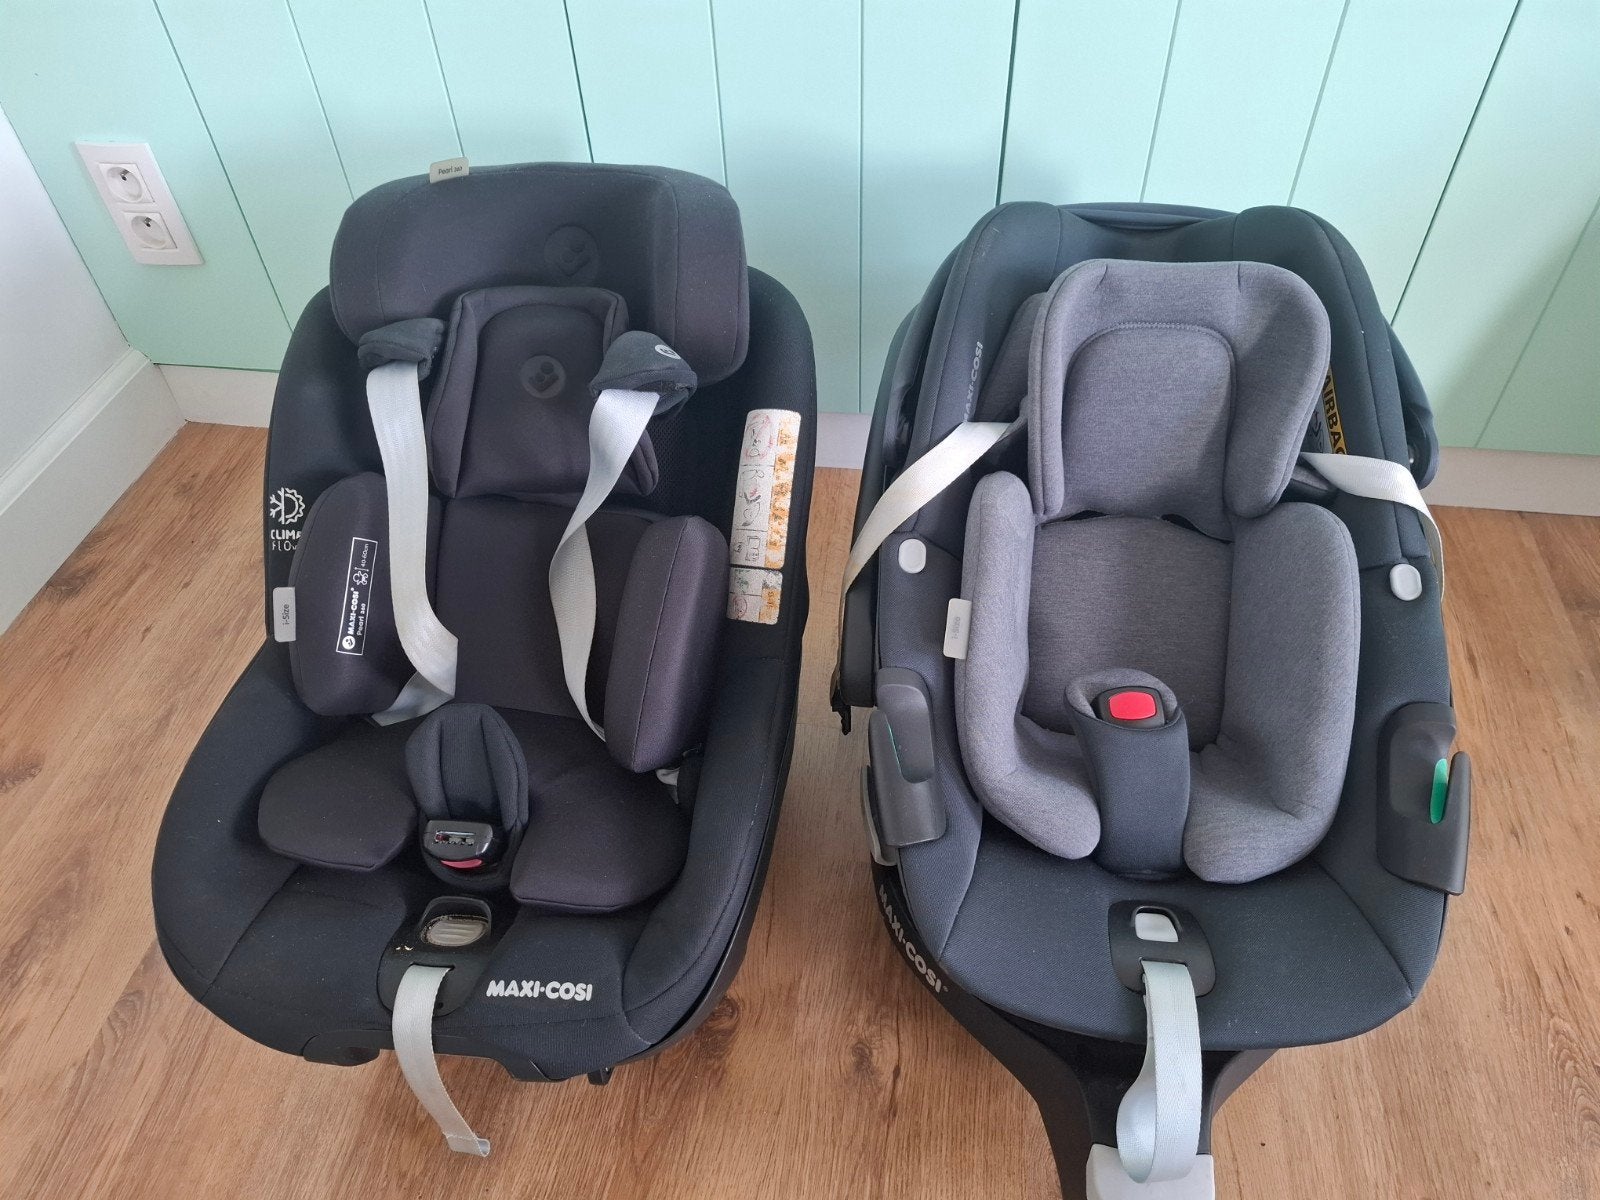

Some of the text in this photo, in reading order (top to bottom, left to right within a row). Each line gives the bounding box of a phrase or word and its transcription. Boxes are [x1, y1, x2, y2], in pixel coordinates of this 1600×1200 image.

[438, 165, 453, 175] Pearl
[282, 603, 290, 626] i-Size
[356, 616, 365, 636] Pearl
